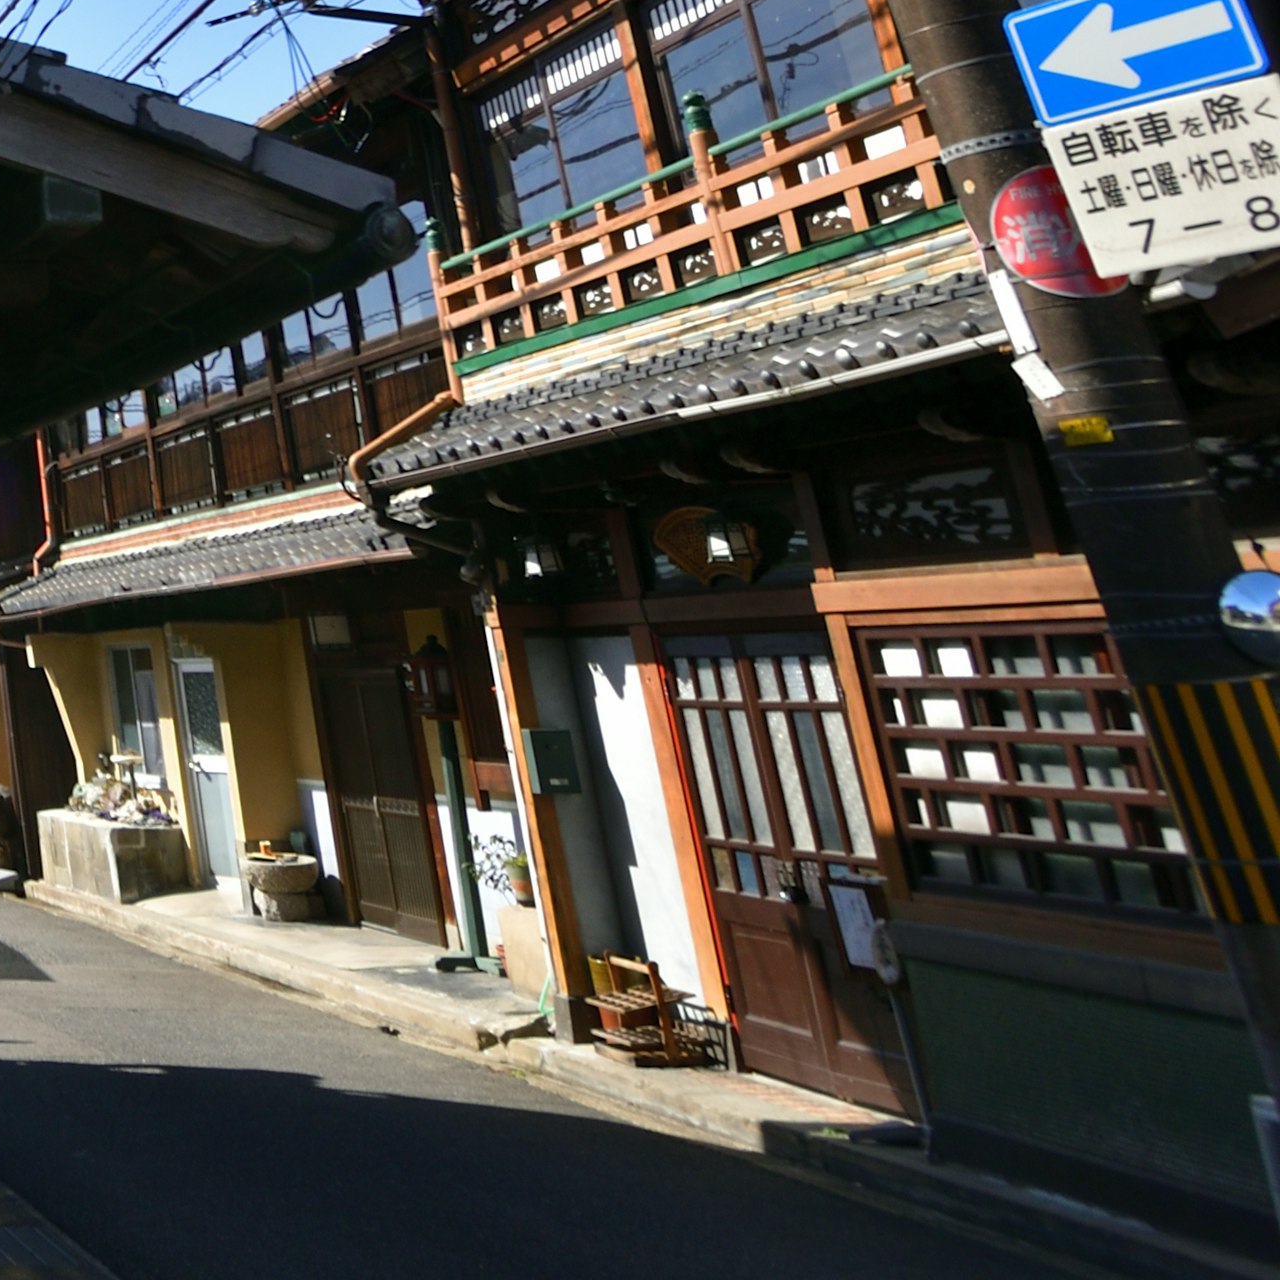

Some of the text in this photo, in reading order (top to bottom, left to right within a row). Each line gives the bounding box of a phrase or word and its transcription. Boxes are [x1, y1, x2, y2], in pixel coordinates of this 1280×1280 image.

[1061, 93, 1279, 167] 自転車を除く
[1008, 184, 1041, 202] FIRE
